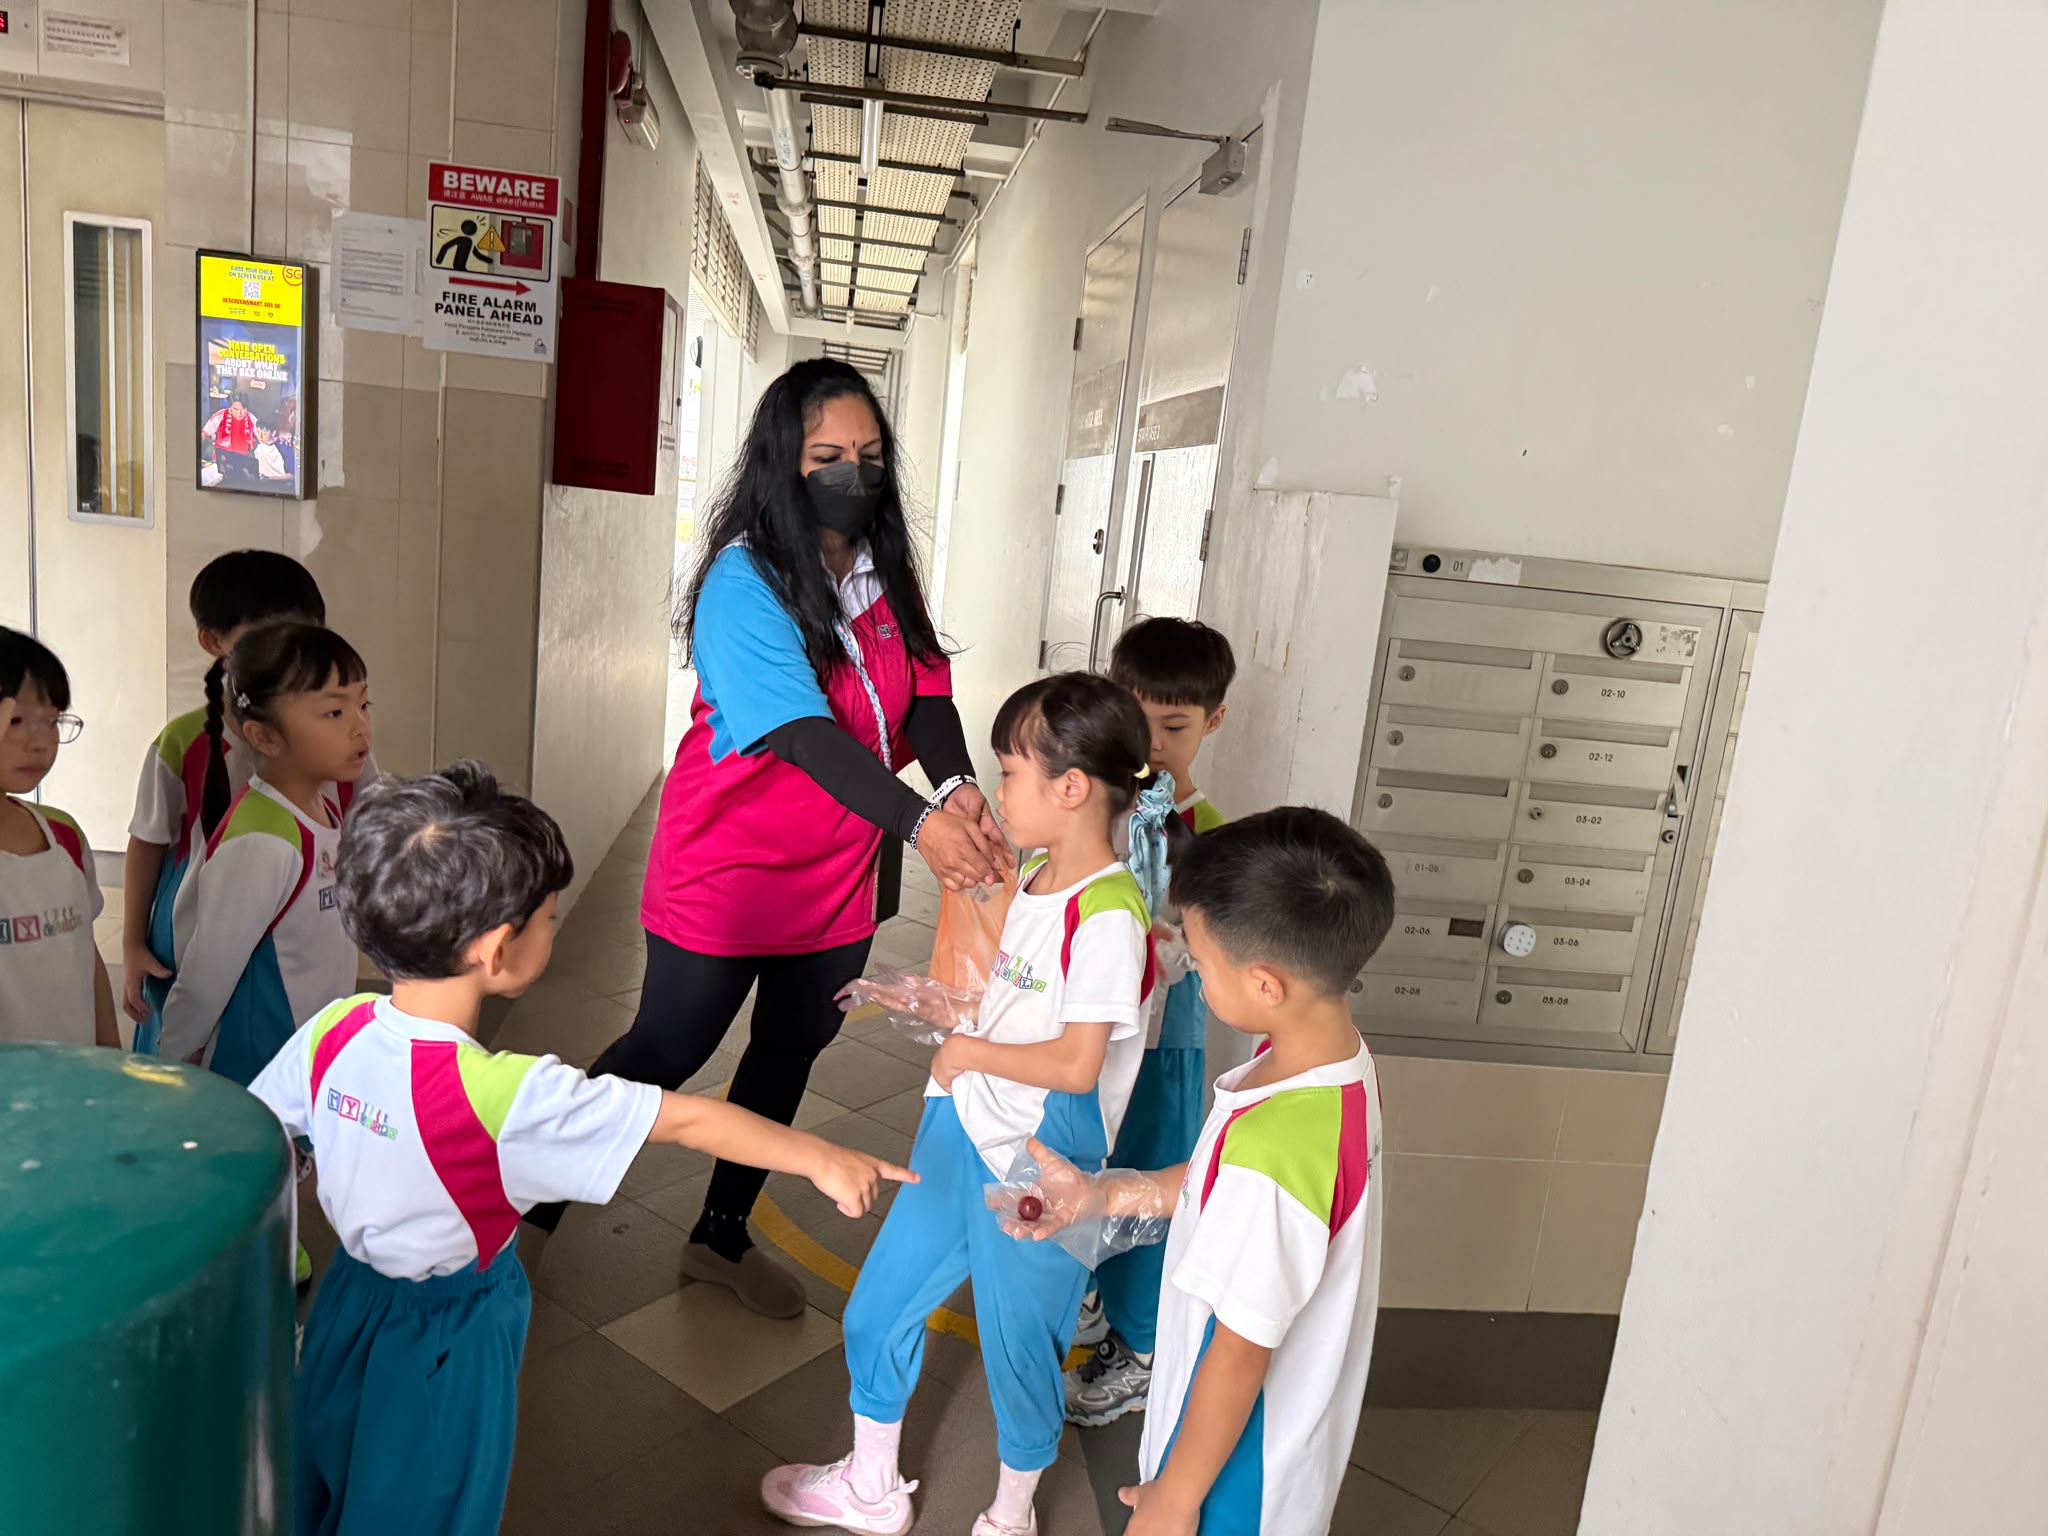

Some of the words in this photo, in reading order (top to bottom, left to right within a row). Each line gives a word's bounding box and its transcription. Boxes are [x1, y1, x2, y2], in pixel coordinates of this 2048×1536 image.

[443, 170, 545, 200] BEWARE
[237, 272, 257, 280] SCREEN
[286, 268, 303, 280] SG
[442, 291, 477, 306] FIRE
[483, 296, 537, 313] ALARM
[434, 303, 485, 319] PANEL
[490, 309, 543, 326] AHEAD
[229, 340, 250, 351] HAVE
[252, 343, 276, 354] OPEN
[218, 348, 286, 365] CONVERSATIONS
[225, 358, 252, 369] ABOUT
[254, 361, 279, 372] WHAT
[216, 364, 238, 377] THEY
[257, 369, 288, 382] ONLINE
[1452, 560, 1464, 573] 01
[1600, 688, 1626, 699] 02-10
[1588, 752, 1614, 762] 02-12
[1575, 815, 1602, 825] 03-02
[1414, 863, 1439, 873] 01-06
[1564, 876, 1591, 886] 03-04
[1404, 925, 1431, 935] 02-06
[1553, 937, 1579, 947] 03-06
[1394, 986, 1421, 996] 02-08
[1542, 996, 1569, 1006] 03-08
